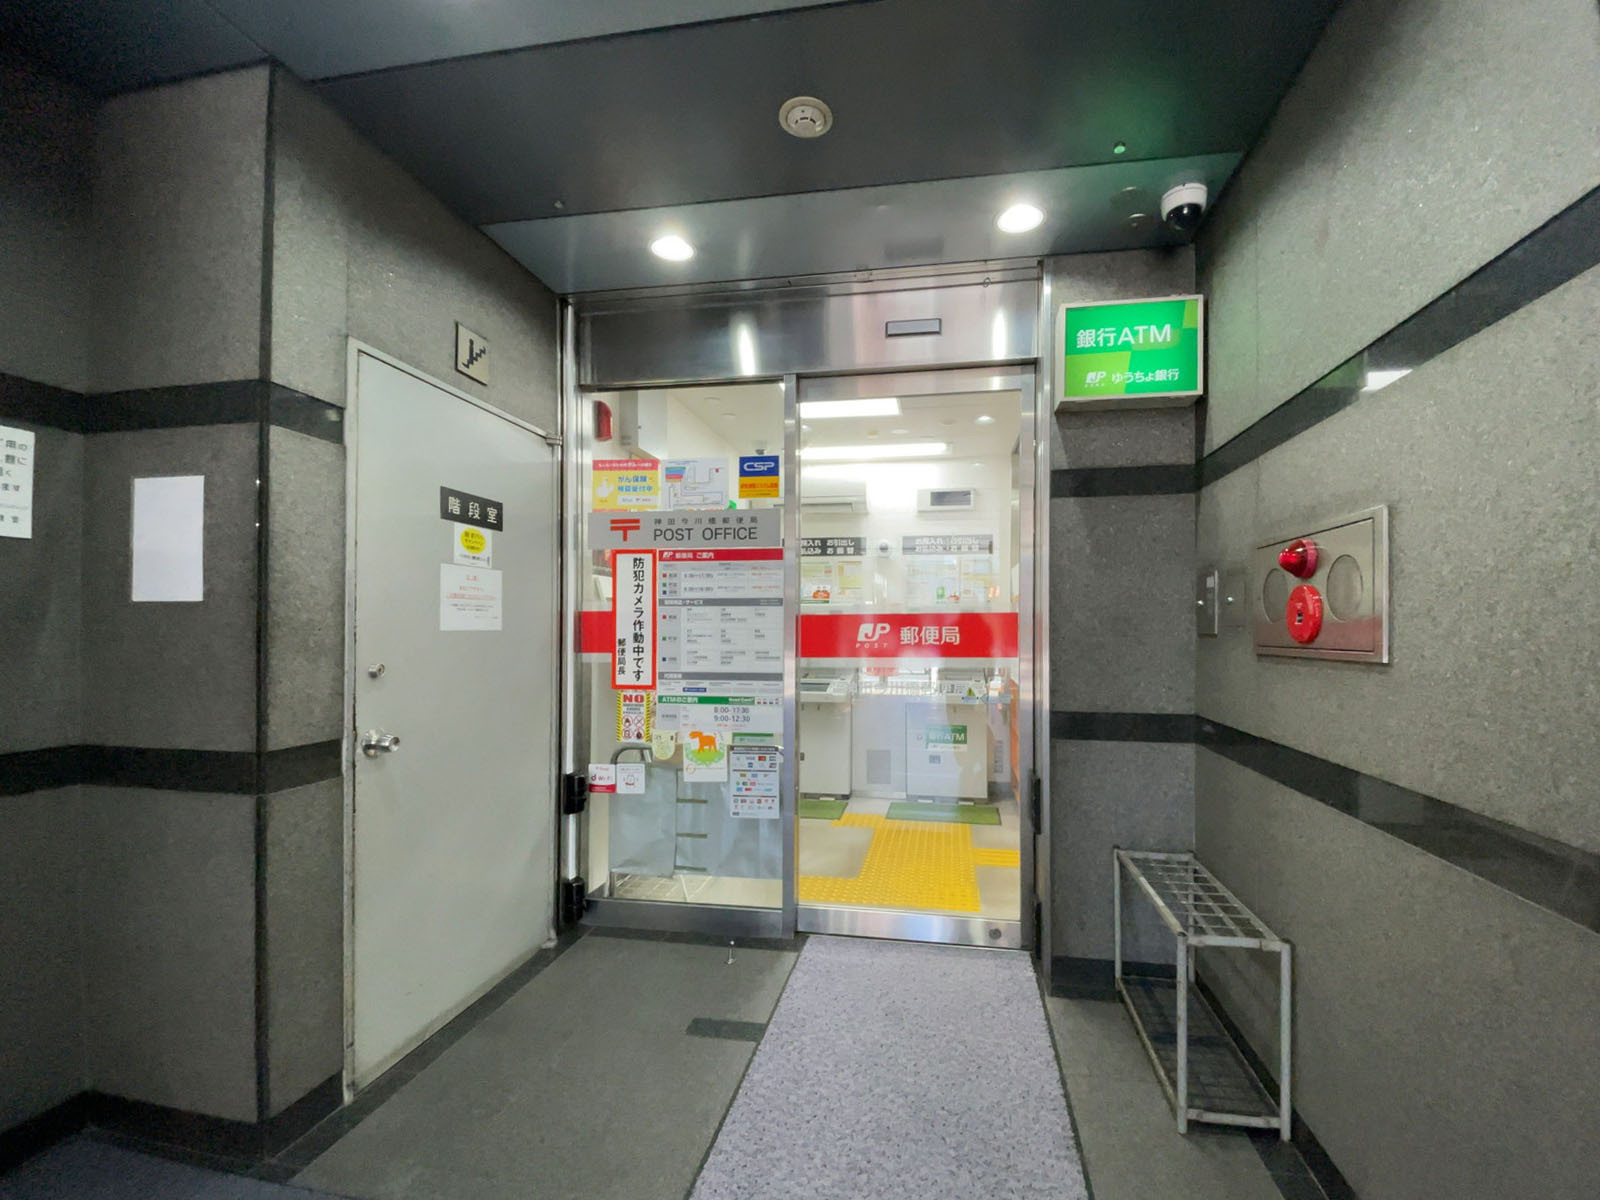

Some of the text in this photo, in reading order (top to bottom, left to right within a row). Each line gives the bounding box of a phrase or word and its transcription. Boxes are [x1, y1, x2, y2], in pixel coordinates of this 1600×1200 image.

[1076, 323, 1171, 348] 銀行ATM
[1112, 368, 1179, 384] ゆうちょ銀行
[743, 462, 775, 471] CSP
[448, 497, 497, 523] 階段室
[653, 526, 758, 541] POST OFFICE
[633, 557, 645, 682] 防犯カメラ作動中です
[857, 623, 960, 645] JP 郵便局
[617, 638, 627, 675] 郵便局長
[623, 694, 644, 703] NO
